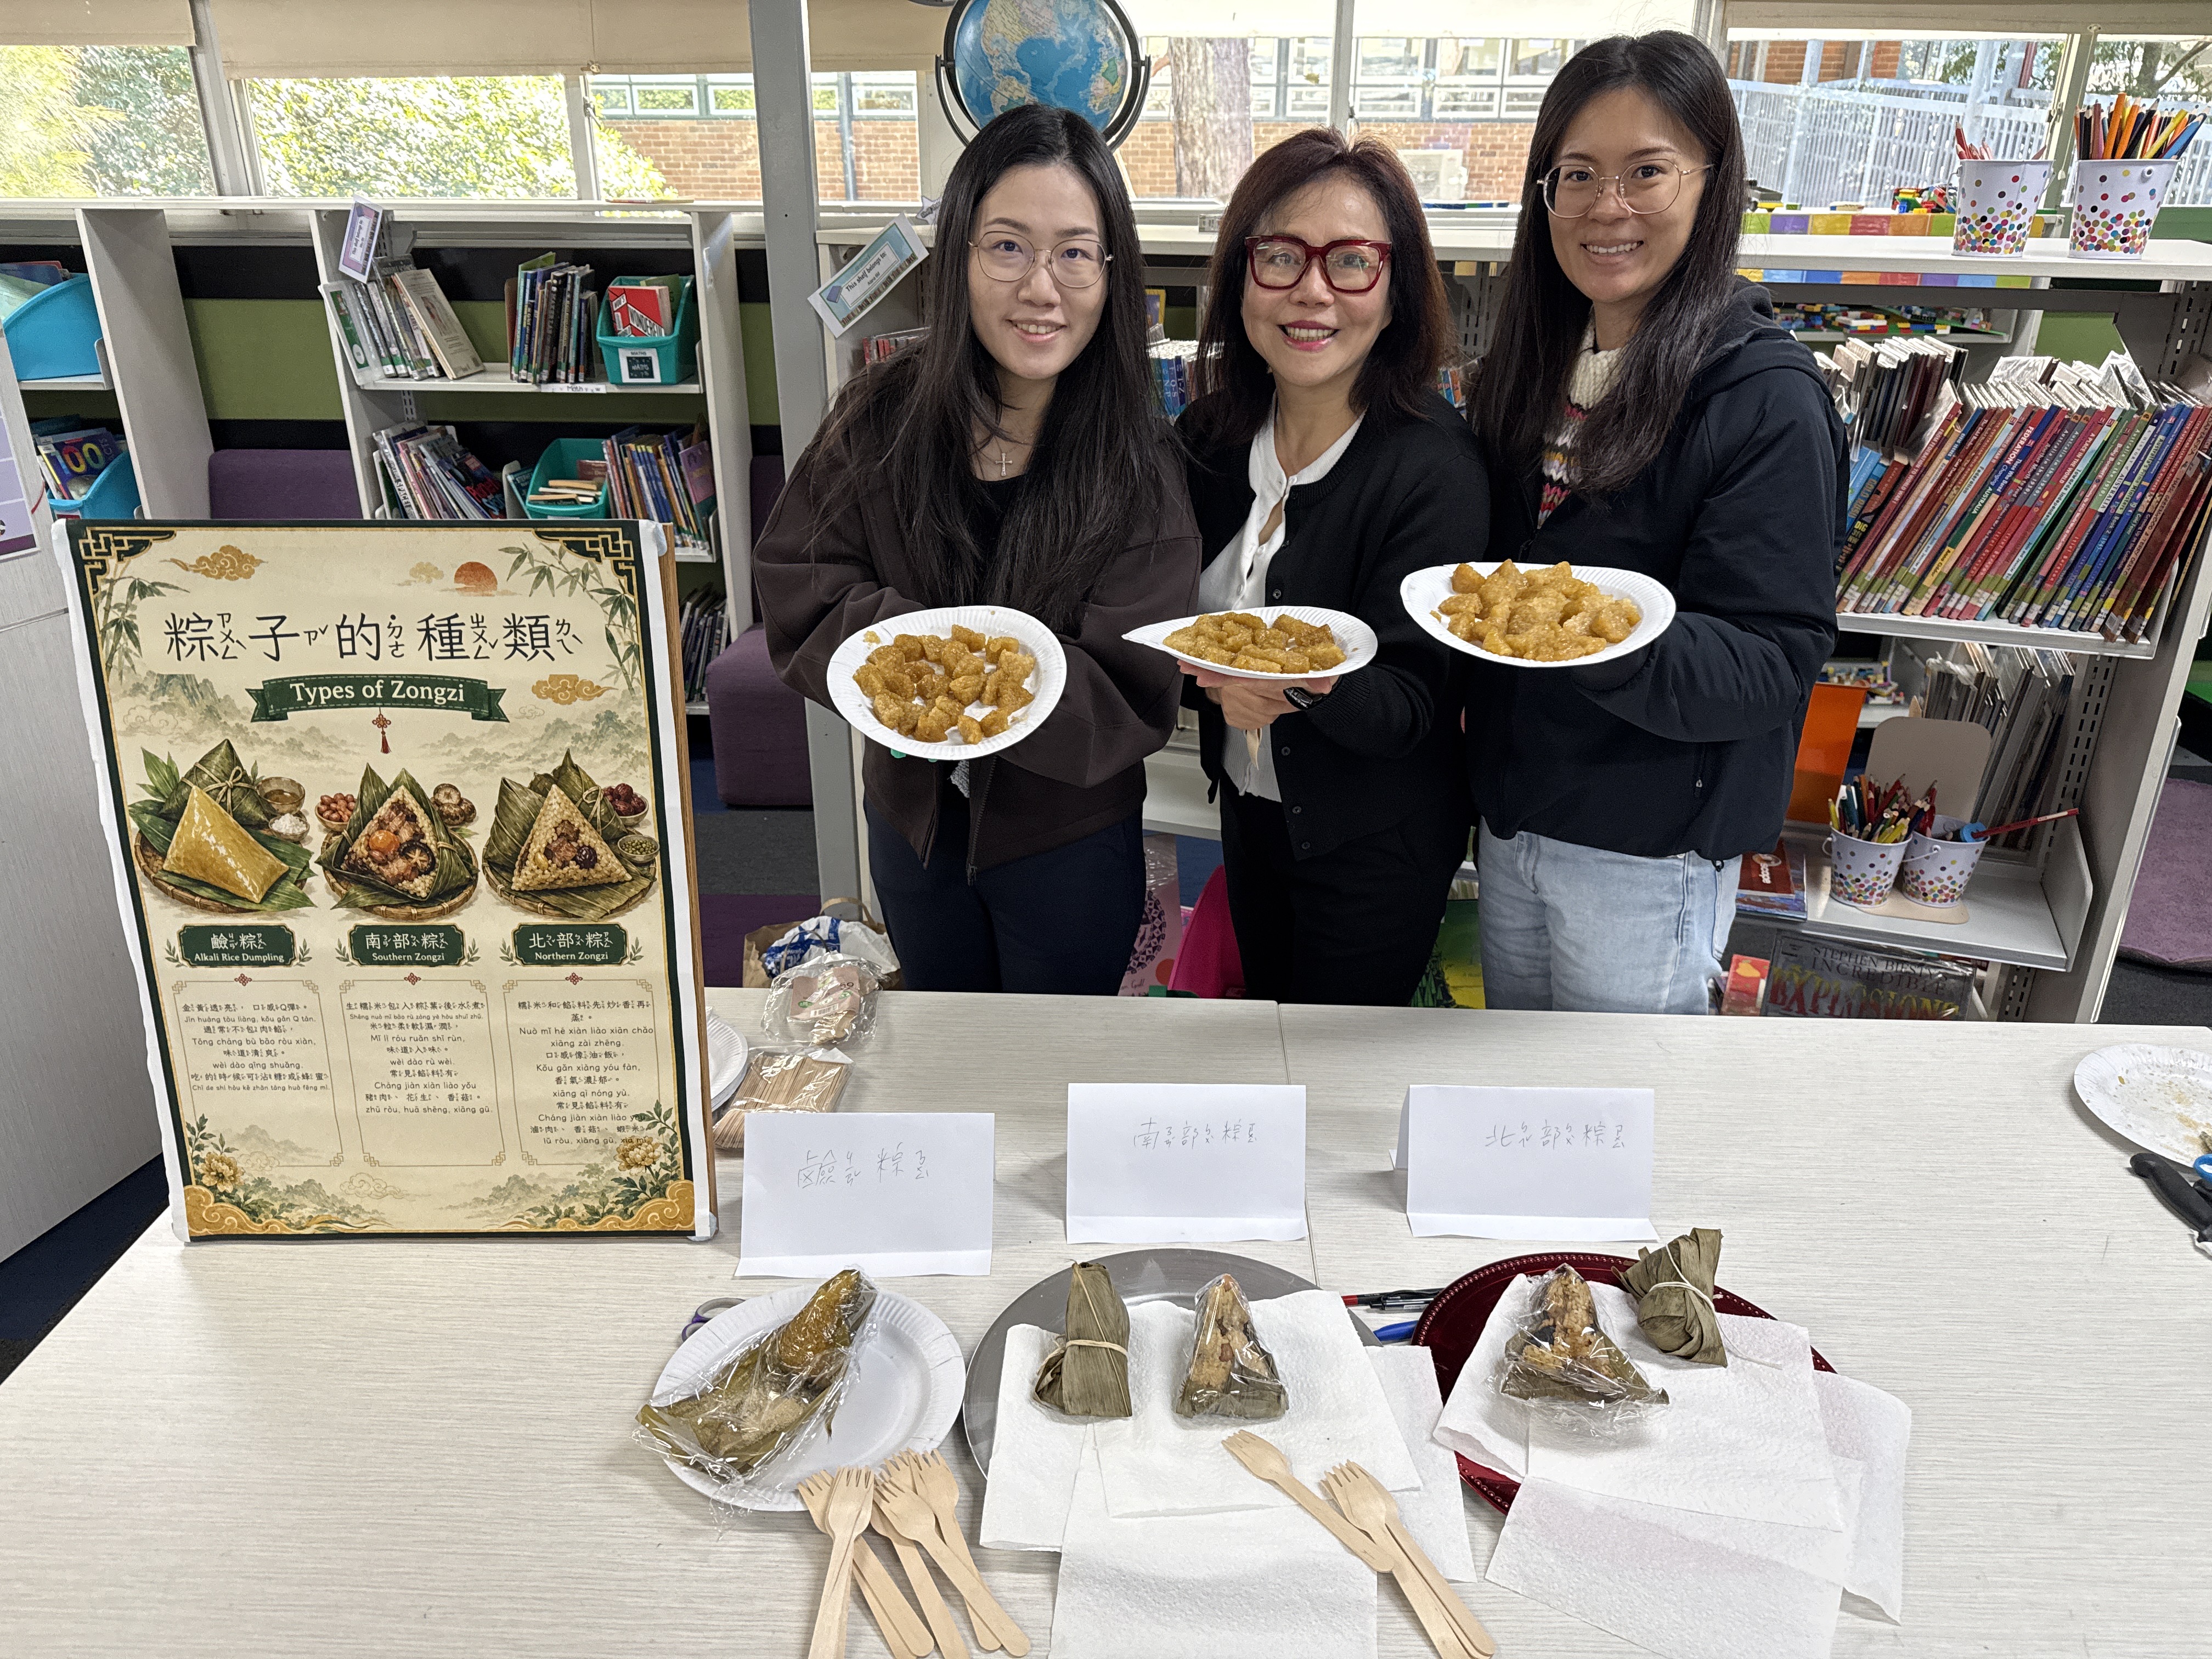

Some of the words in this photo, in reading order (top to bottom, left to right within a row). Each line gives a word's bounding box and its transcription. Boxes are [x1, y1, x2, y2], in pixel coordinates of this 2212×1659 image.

[845, 280, 857, 292] This
[855, 270, 868, 284] shelf
[865, 256, 882, 273] belongs
[1932, 427, 1944, 442] FROM
[2184, 419, 2193, 432] THE
[2001, 430, 2016, 448] WORLD
[2047, 429, 2069, 457] Australia
[2058, 430, 2079, 458] Australia
[2079, 436, 2093, 452] PLACE
[2121, 428, 2140, 458] Australia
[2187, 414, 2212, 456] DAMARRA
[1993, 446, 2005, 460] WAR
[2004, 425, 2034, 465] FEDERATION
[2034, 442, 2051, 464] Another
[2075, 450, 2083, 458] IN
[2111, 442, 2123, 457] Baby
[2143, 437, 2163, 470] Australia's
[2169, 431, 2186, 459] AUSTRALIAN
[1914, 441, 1936, 469] FEDERATION
[2010, 457, 2022, 471] Those
[2068, 456, 2079, 469] THE
[2116, 458, 2123, 466] in
[1910, 467, 1918, 475] TO
[2005, 470, 2014, 479] Who
[2023, 463, 2038, 481] Mouth
[2034, 466, 2045, 477] the
[2045, 467, 2055, 478] the
[2097, 454, 2114, 479] Boomers
[2110, 466, 2119, 477] the
[2160, 458, 2171, 473] GOLD
[1900, 473, 1914, 490] WORLD
[1962, 465, 1984, 495] Federation
[1989, 463, 2008, 487] Changing
[2058, 467, 2072, 484] WORLD
[2063, 467, 2081, 491] Towards
[2151, 471, 2164, 491] RUSHES
[396, 480, 409, 507] SPACE!
[1996, 478, 2008, 493] Dared
[2012, 486, 2023, 498] Feed
[2022, 477, 2037, 495] 1930s
[2032, 478, 2047, 497] 1940s
[2098, 479, 2111, 498] 1910s
[2099, 472, 2126, 511] AUSTRALIA
[1893, 489, 1904, 502] WAR
[1971, 487, 1994, 515] AUSTRALIA
[2119, 484, 2136, 512] Ministers
[2039, 491, 2066, 527] Independence
[2132, 512, 2141, 523] Gold
[2147, 494, 2169, 533] GREENWOOD
[2109, 515, 2119, 529] Book
[2126, 522, 2136, 535] Fever
[1940, 549, 1951, 562] Anna
[2134, 537, 2146, 556] TERRY
[2122, 556, 2136, 577] DENTO
[290, 682, 356, 703] Types
[362, 680, 385, 698] of
[391, 679, 465, 703] Zongzi
[194, 953, 219, 961] Alkali
[222, 953, 240, 961] Rice
[241, 953, 285, 963] Dumpling
[372, 952, 412, 961] Southern
[415, 952, 445, 963] Zongzi
[535, 952, 576, 961] Northern
[578, 952, 608, 962] Zongzi
[1813, 946, 1878, 968] STEPHEN
[1812, 956, 1946, 995] INCREDIBLE
[1769, 964, 1960, 1021] EXPLOSIONS
[631, 1025, 654, 1035] chǎo
